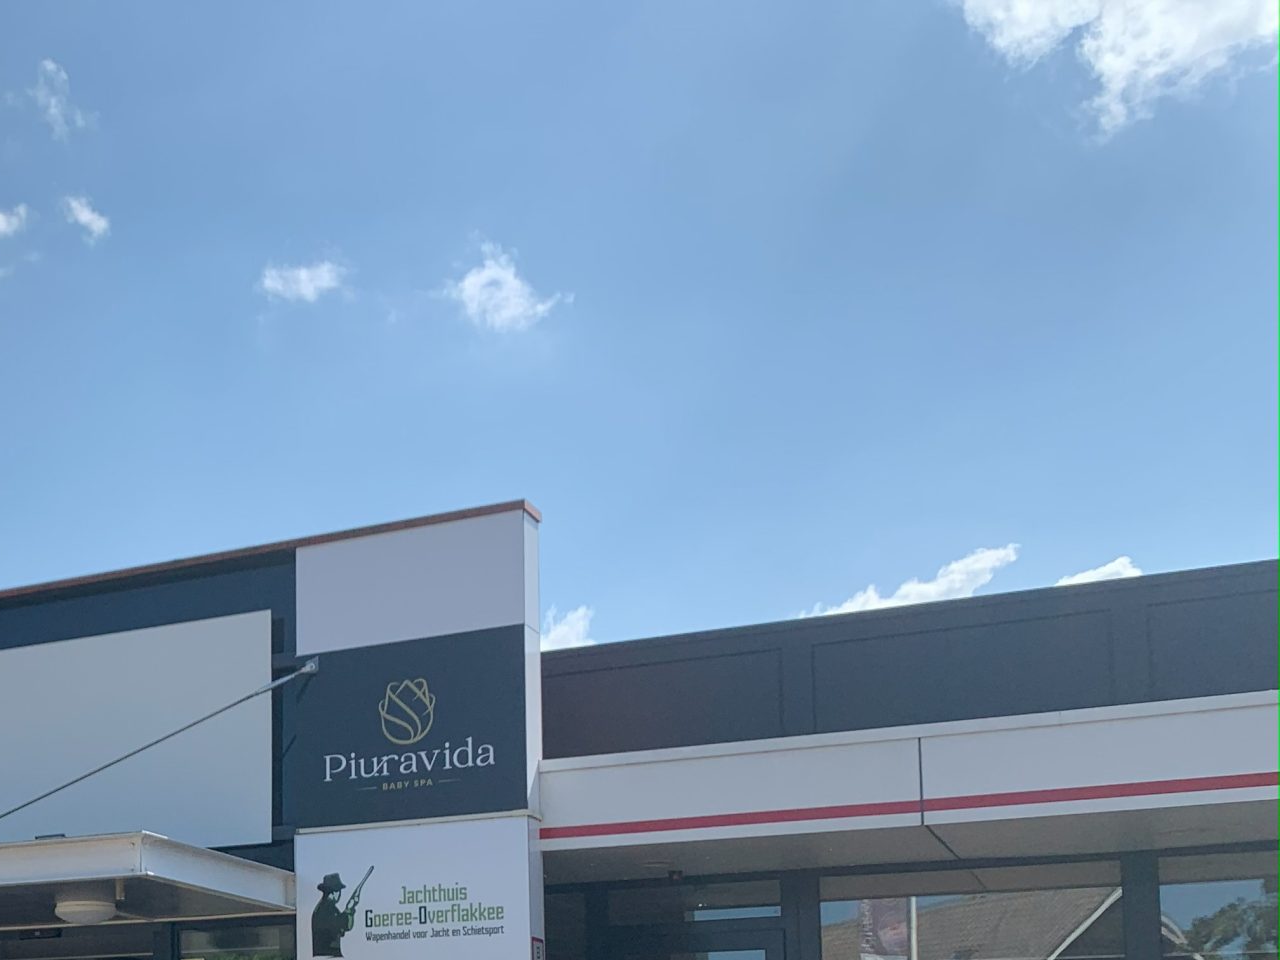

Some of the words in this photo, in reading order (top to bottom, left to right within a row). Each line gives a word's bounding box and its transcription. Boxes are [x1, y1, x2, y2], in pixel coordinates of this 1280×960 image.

[323, 736, 496, 782] Piuravida
[382, 780, 410, 791] BABY
[413, 779, 433, 788] SPA
[399, 882, 467, 905] Jachthuis
[365, 902, 505, 928] Goeree-Overflakkee
[365, 929, 411, 943] Wapenhandel
[412, 931, 428, 939] voor
[430, 927, 450, 938] Jacht
[451, 928, 461, 936] en
[462, 925, 505, 937] Schietsport
